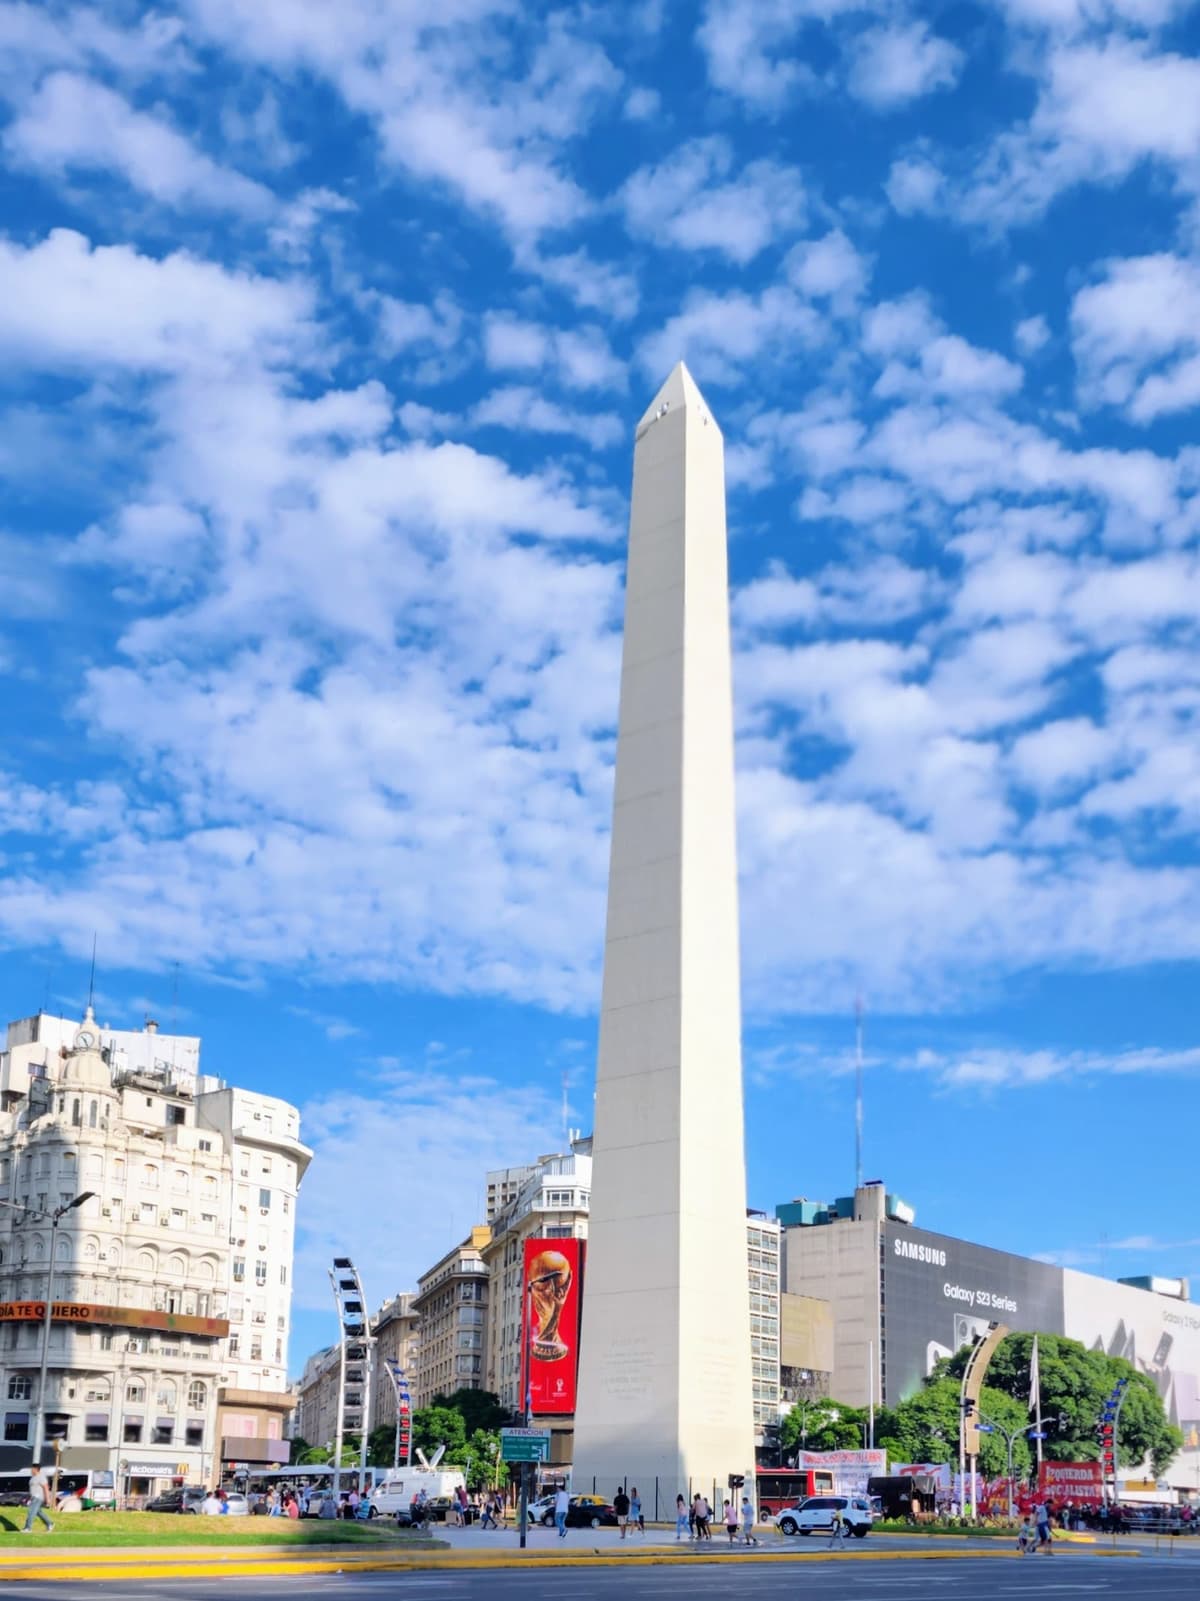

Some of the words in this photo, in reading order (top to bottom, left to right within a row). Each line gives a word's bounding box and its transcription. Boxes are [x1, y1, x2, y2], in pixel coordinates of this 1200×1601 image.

[894, 1238, 946, 1267] SAMSUNG
[943, 1282, 975, 1307] Galaxy
[976, 1290, 991, 1307] S23
[991, 1294, 1018, 1313] Series
[17, 1305, 32, 1316] TE
[130, 1465, 173, 1474] McDonald's
